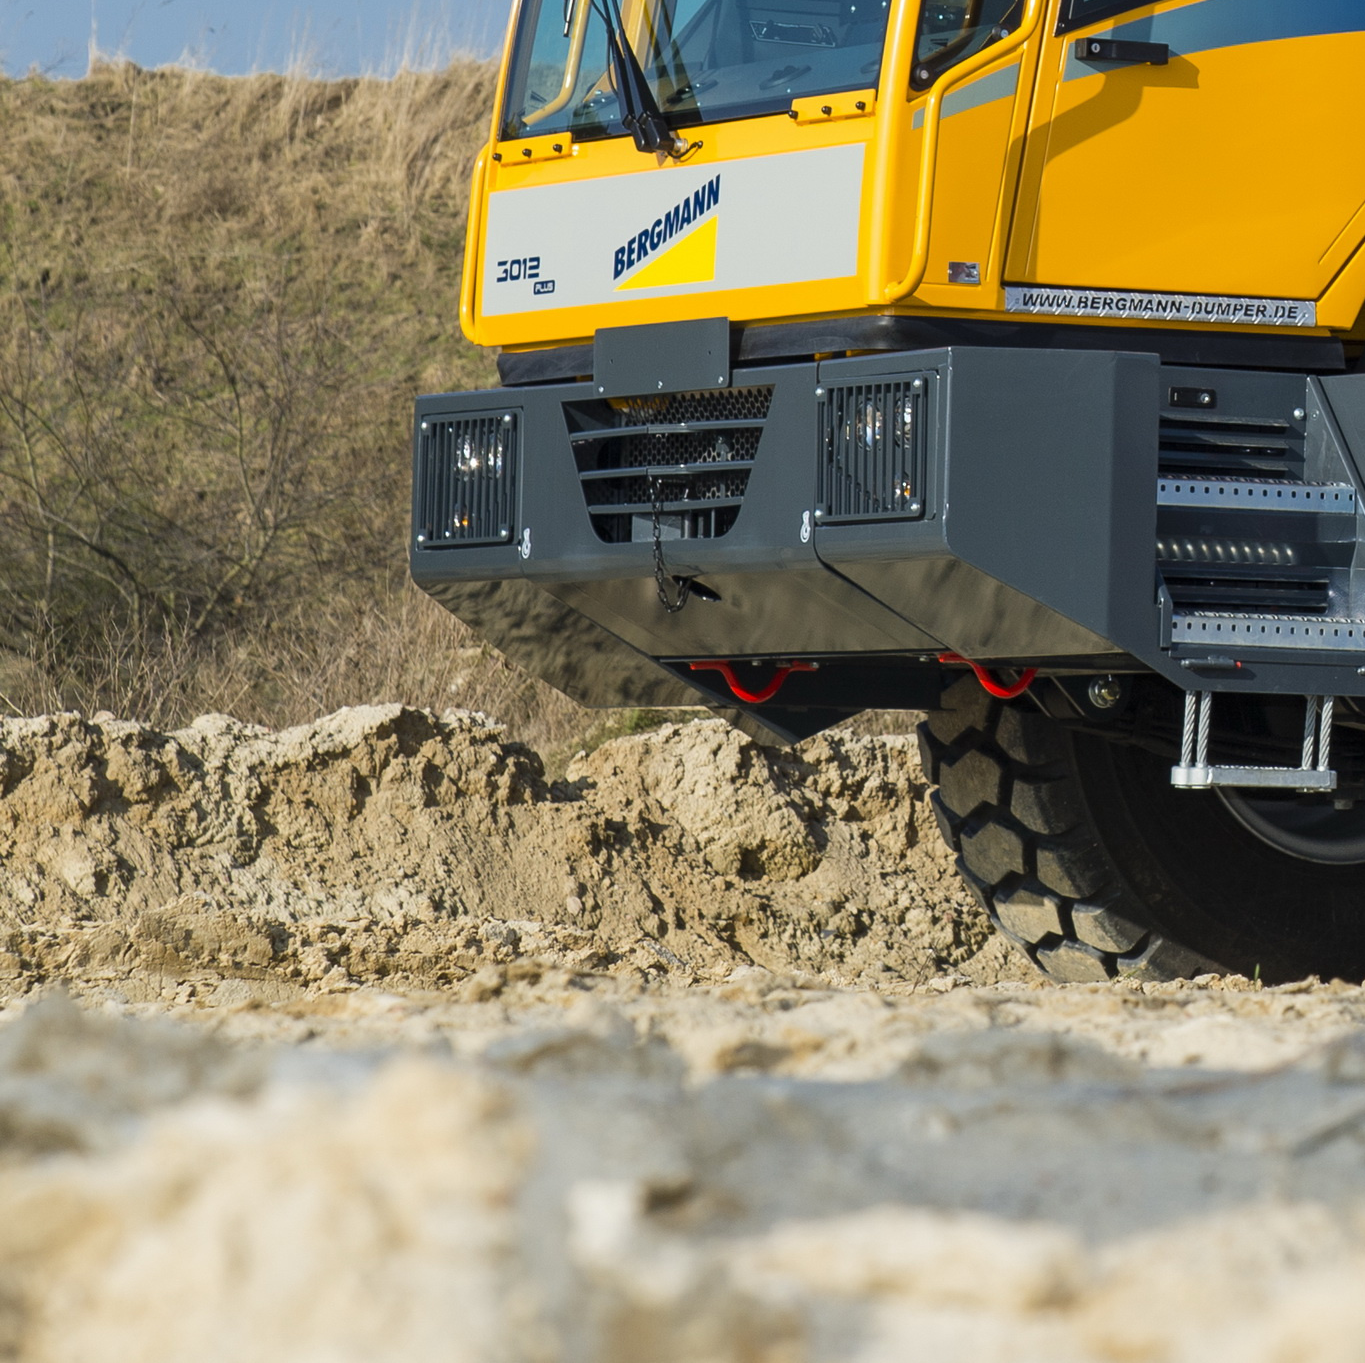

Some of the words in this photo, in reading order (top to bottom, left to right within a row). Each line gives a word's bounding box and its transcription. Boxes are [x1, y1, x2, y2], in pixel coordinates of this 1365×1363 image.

[612, 172, 721, 281] BERGMANN
[495, 256, 541, 283] 3012
[535, 281, 554, 293] PLUS
[1021, 292, 1300, 320] WWW.BERGMANN-DUMPER.DE
